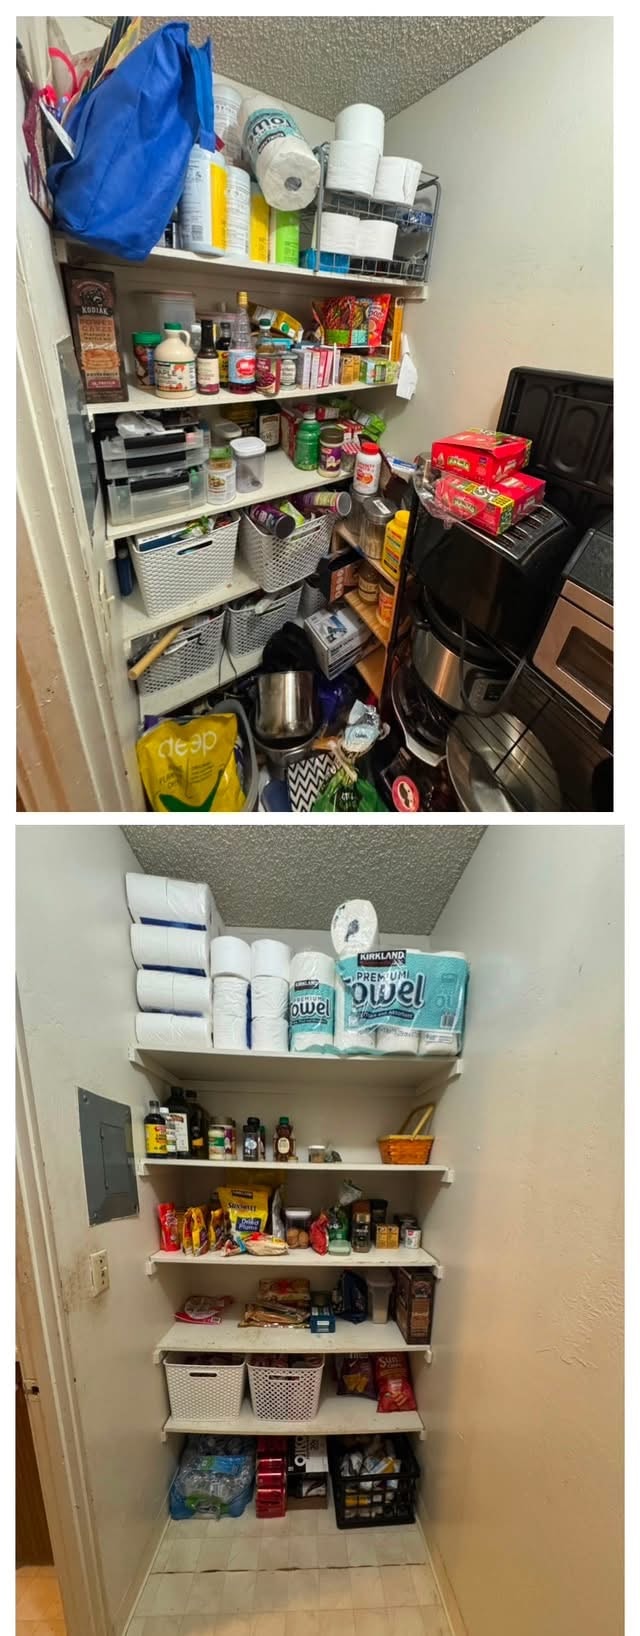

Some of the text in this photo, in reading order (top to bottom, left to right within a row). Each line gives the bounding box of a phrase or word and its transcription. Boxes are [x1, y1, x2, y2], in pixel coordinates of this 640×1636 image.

[82, 306, 109, 315] KODIAK
[359, 951, 405, 960] KIRKLAND
[290, 999, 330, 1017] owel
[379, 1356, 400, 1368] Sun
